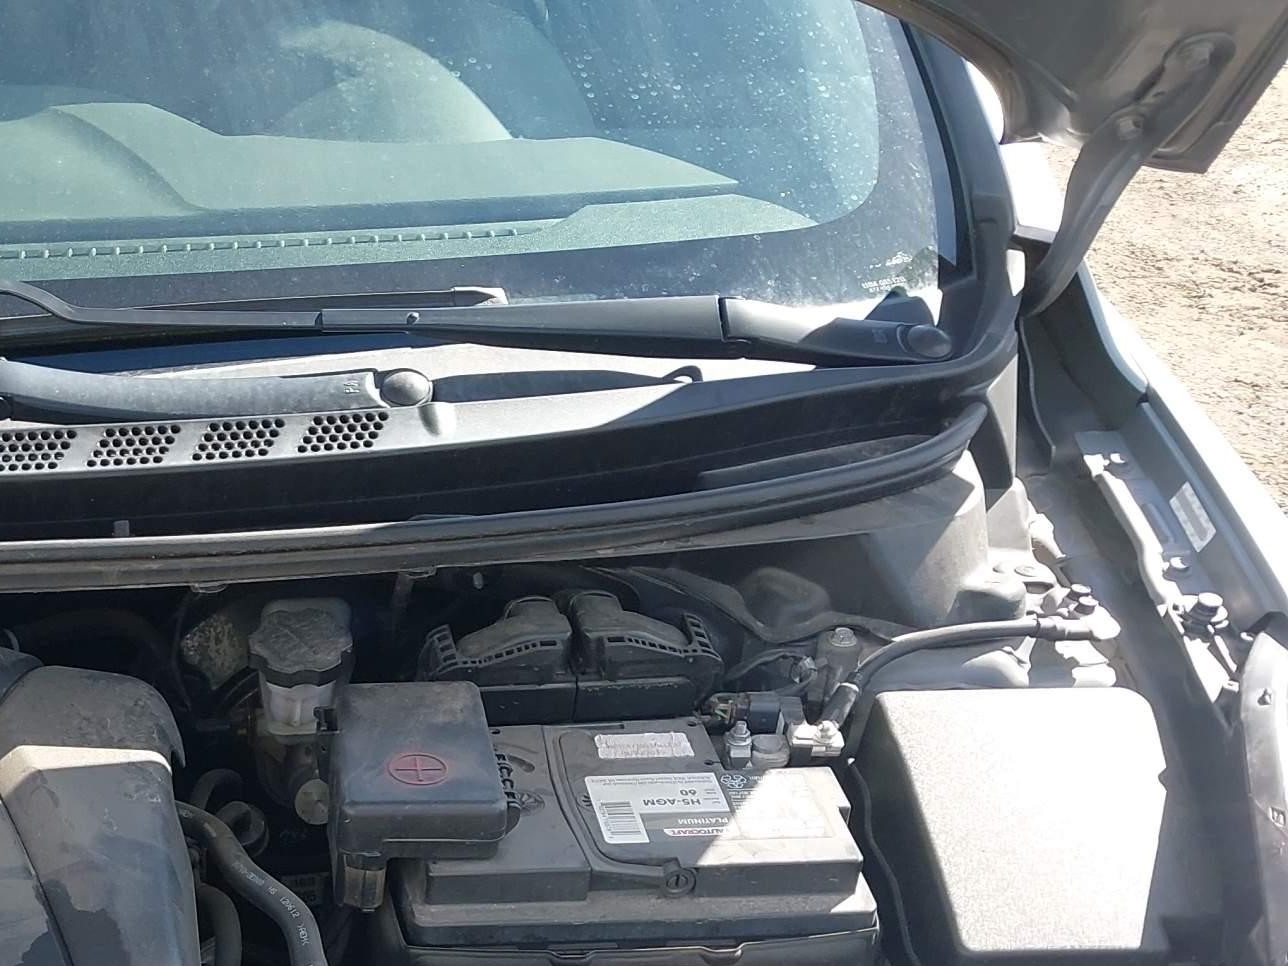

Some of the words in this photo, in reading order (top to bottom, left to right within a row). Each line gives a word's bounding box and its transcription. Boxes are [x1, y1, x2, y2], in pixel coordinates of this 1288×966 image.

[643, 798, 702, 807] H5-AGM
[678, 817, 729, 826] PLATINUM
[671, 827, 724, 835] AUTOCRAFT
